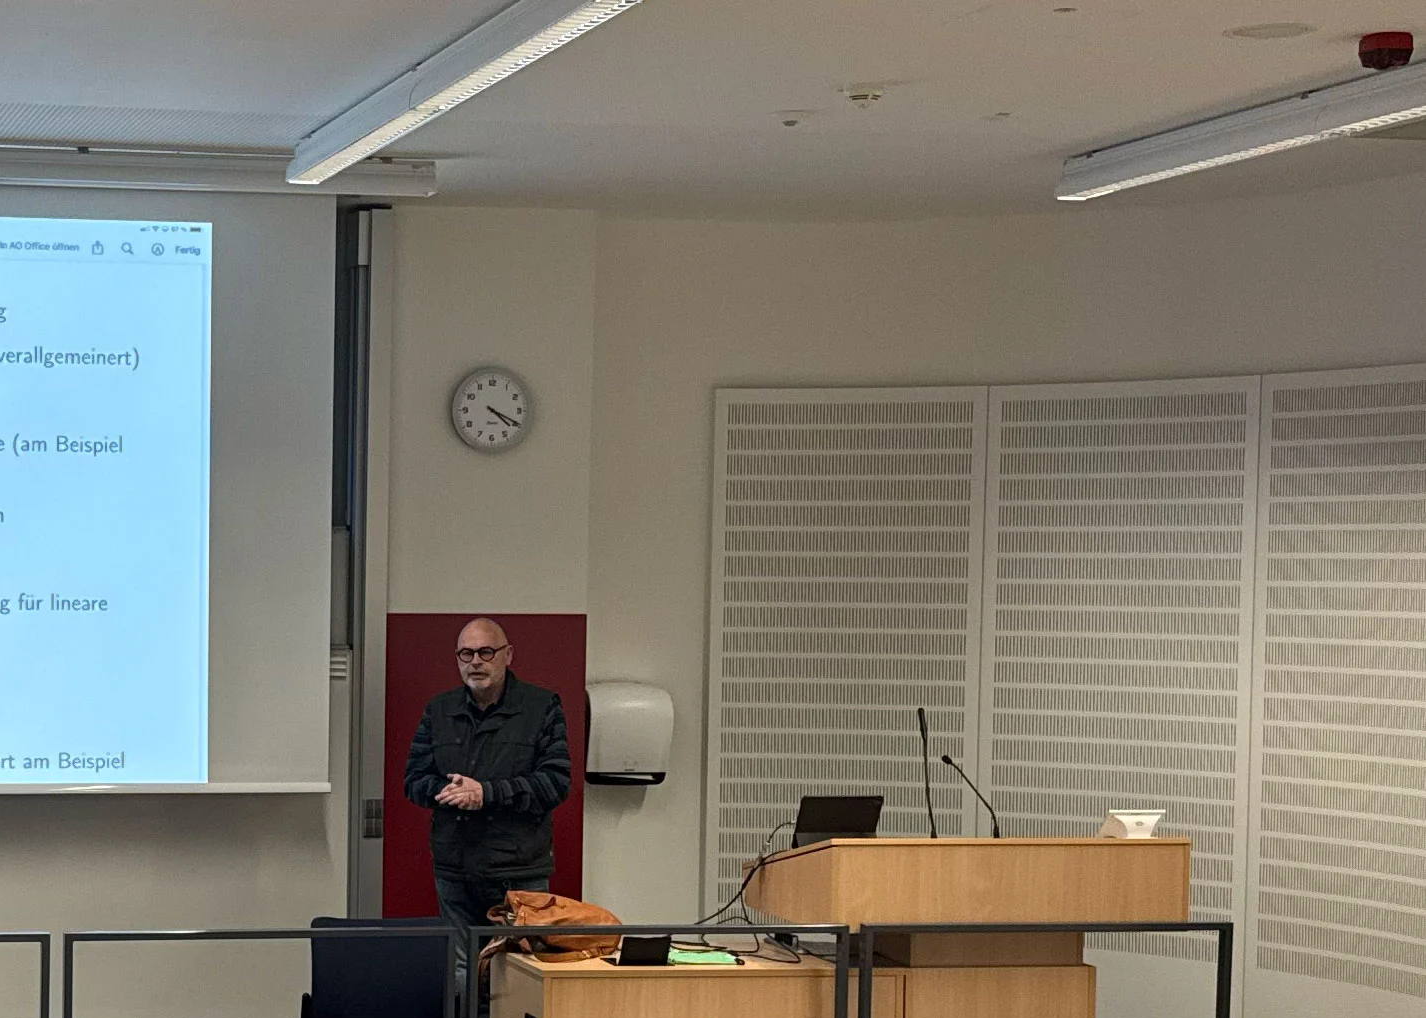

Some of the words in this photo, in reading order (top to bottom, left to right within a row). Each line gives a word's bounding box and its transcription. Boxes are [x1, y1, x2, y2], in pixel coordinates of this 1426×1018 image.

[25, 241, 51, 251] Office
[174, 245, 201, 257] Fertig
[12, 432, 48, 457] (am
[55, 435, 123, 457] Beispiel
[17, 591, 44, 611] für
[50, 593, 109, 612] lineare
[22, 757, 50, 770] am
[58, 751, 125, 774] Beispiel
